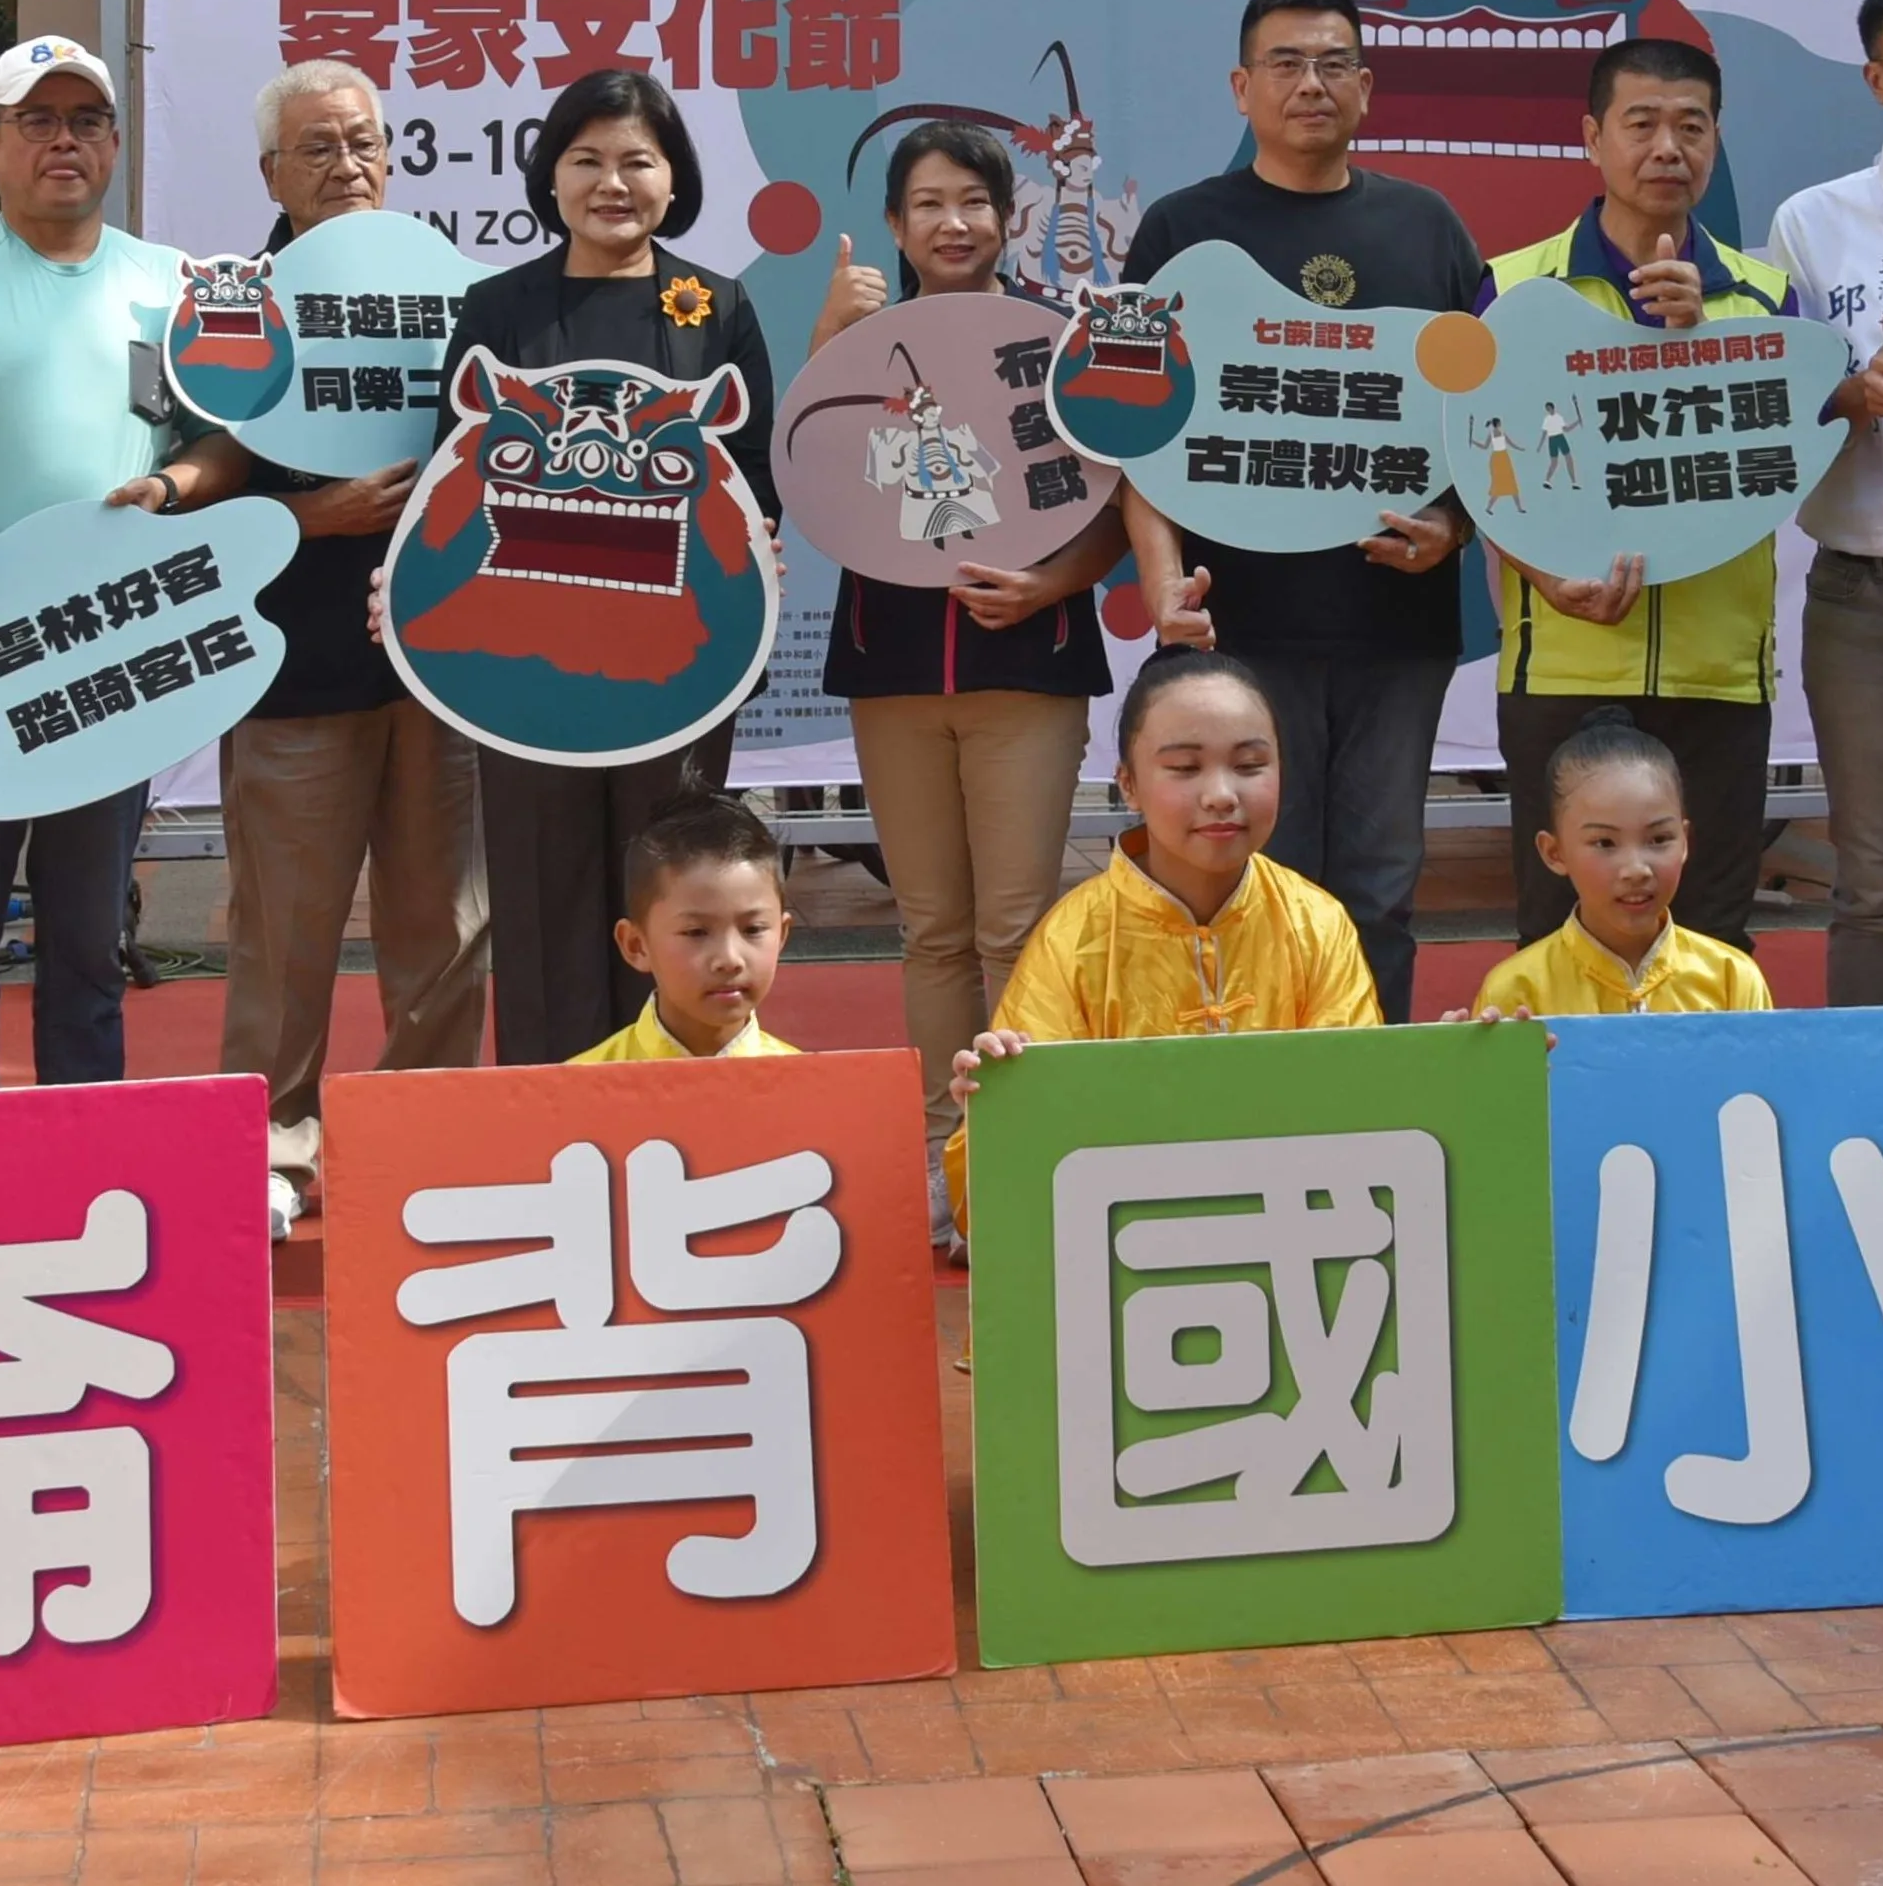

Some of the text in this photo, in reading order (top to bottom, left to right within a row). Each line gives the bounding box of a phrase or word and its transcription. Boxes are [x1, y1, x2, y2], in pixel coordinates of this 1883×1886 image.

[476, 209, 550, 245] ZO
[1566, 332, 1786, 377] 中秋夜與神同行
[1220, 364, 1403, 422] 崇遠堂
[1597, 378, 1793, 444] 水汴頭
[1185, 435, 1431, 496] 古禮秋祭
[1605, 445, 1798, 510] 迎暗景
[6, 614, 256, 755] 踏騎客庄
